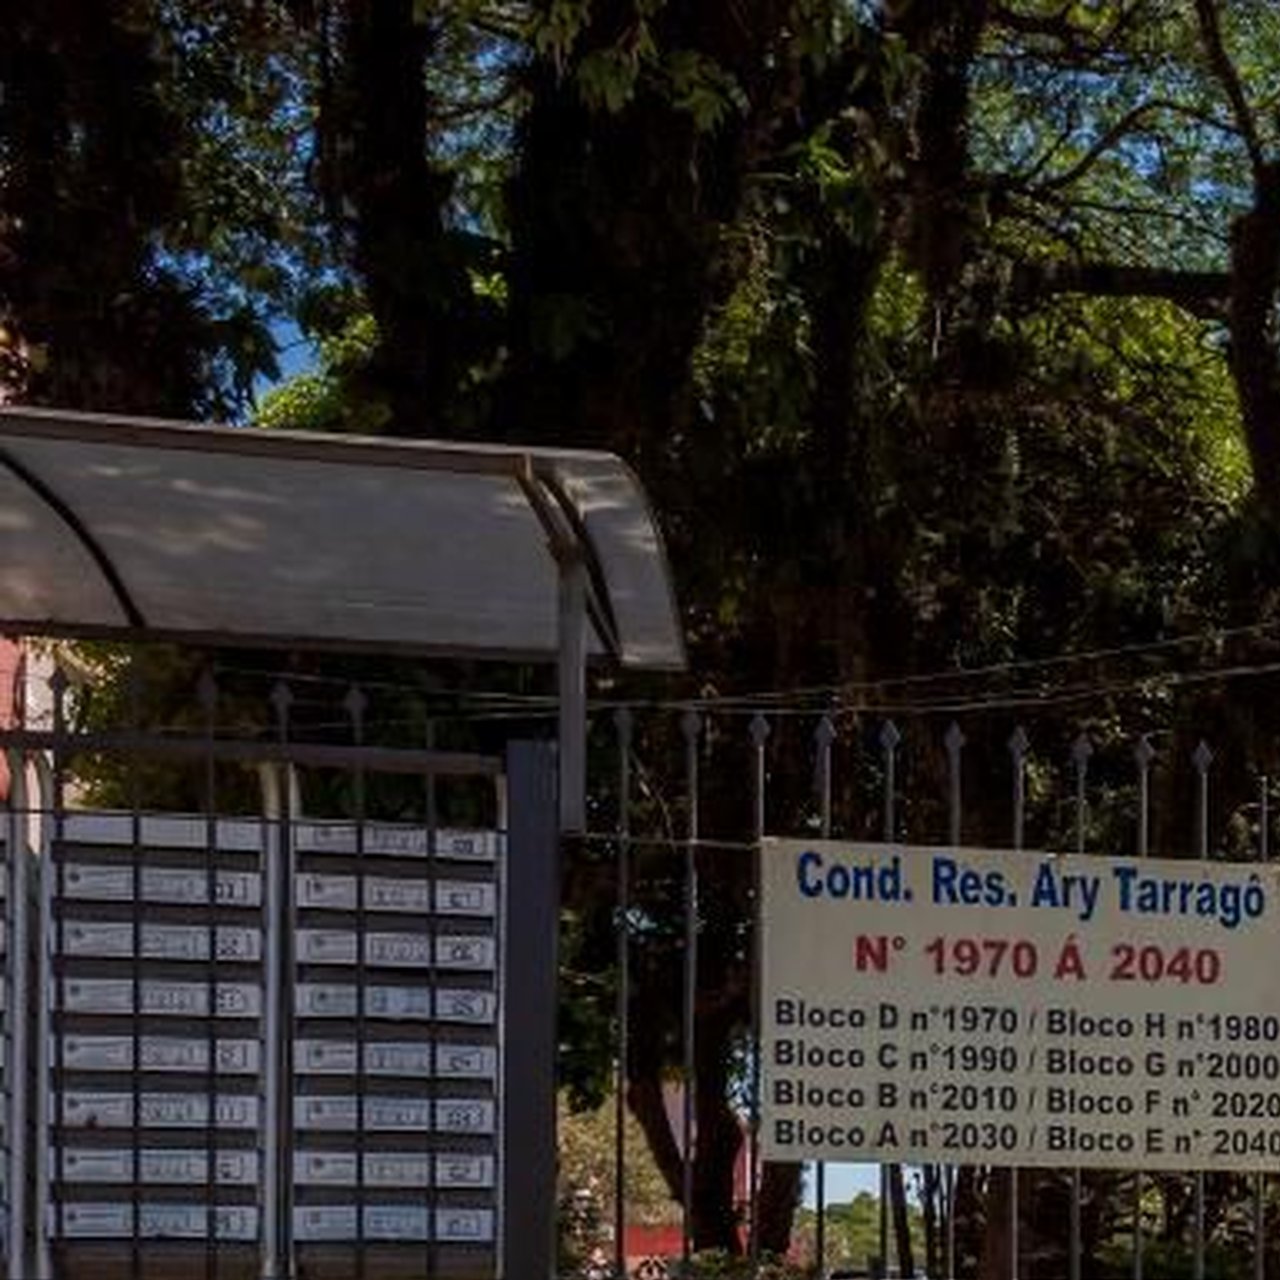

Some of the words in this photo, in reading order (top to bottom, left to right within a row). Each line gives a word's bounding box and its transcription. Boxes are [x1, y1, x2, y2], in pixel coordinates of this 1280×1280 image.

[797, 851, 912, 902] Cond.
[932, 856, 1017, 907] Res.
[1031, 863, 1099, 921] Ary
[1113, 866, 1265, 928] Tarragô
[926, 936, 1038, 979] 1970
[1110, 943, 1221, 985] 2040
[775, 1000, 866, 1028] Bloco
[880, 1003, 899, 1030] D
[1047, 1009, 1135, 1037] Bloco
[1145, 1013, 1166, 1039] H
[774, 1040, 865, 1068] Bloco
[878, 1043, 899, 1070] C
[1047, 1048, 1135, 1076] Bloco
[1145, 1052, 1167, 1078] G
[774, 1079, 865, 1108] Bloco
[878, 1083, 899, 1109] B
[1047, 1087, 1135, 1115] Bloco
[1145, 1089, 1162, 1115] F
[774, 1119, 865, 1147] Bloco
[876, 1120, 899, 1148] A
[1047, 1125, 1135, 1153] Bloco
[1145, 1128, 1166, 1154] E
